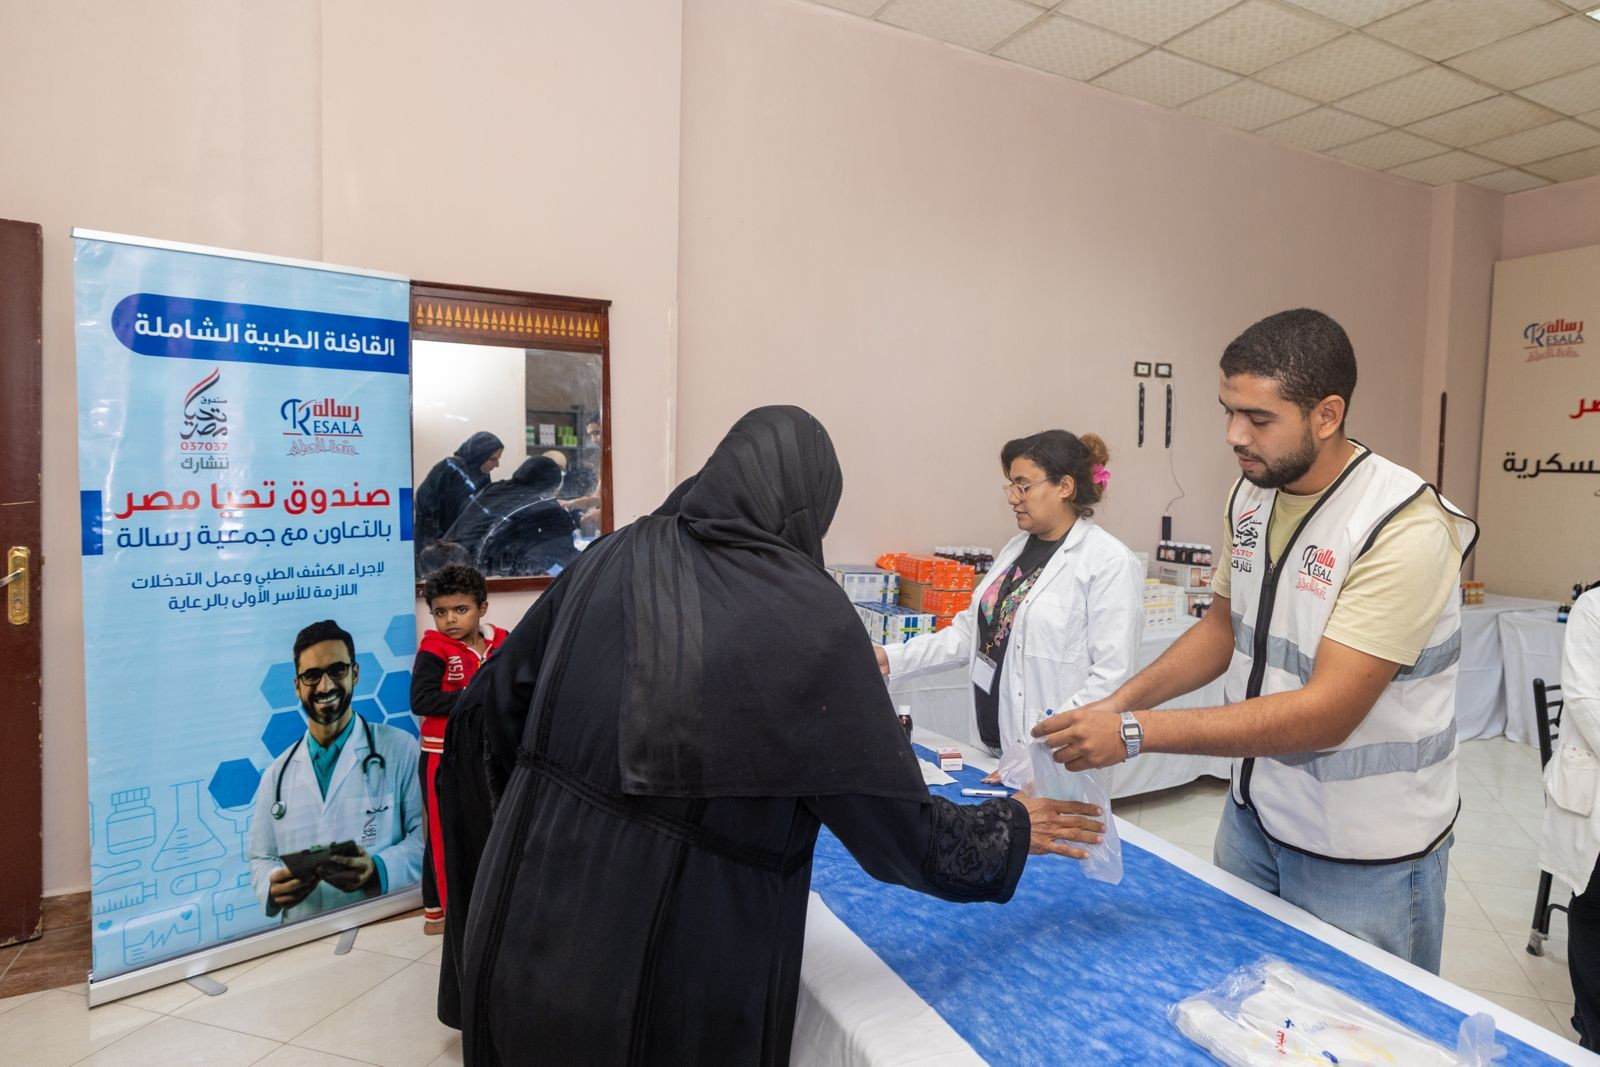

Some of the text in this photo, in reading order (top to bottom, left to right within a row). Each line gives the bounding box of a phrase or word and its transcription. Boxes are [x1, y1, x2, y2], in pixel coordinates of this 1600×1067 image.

[134, 312, 395, 356] القافلة الطبية الشاملة
[281, 399, 362, 436] RESALA
[313, 398, 360, 422] رسالة
[180, 441, 228, 451] 037037
[181, 456, 229, 474] نتشارك
[1503, 452, 1600, 479] سكرية
[114, 480, 390, 519] صندوق تحيا مصر
[117, 519, 392, 551] بالتعاون مع جمعية رسالة
[297, 563, 345, 579] الكشف
[347, 561, 385, 578] لإجراء
[1303, 545, 1332, 582] RESAL
[131, 572, 202, 590] التدخلات
[205, 571, 252, 588] وعمل
[168, 583, 358, 613] اللازمة للأسر الأولى بالرعاية
[448, 655, 465, 681] USN
